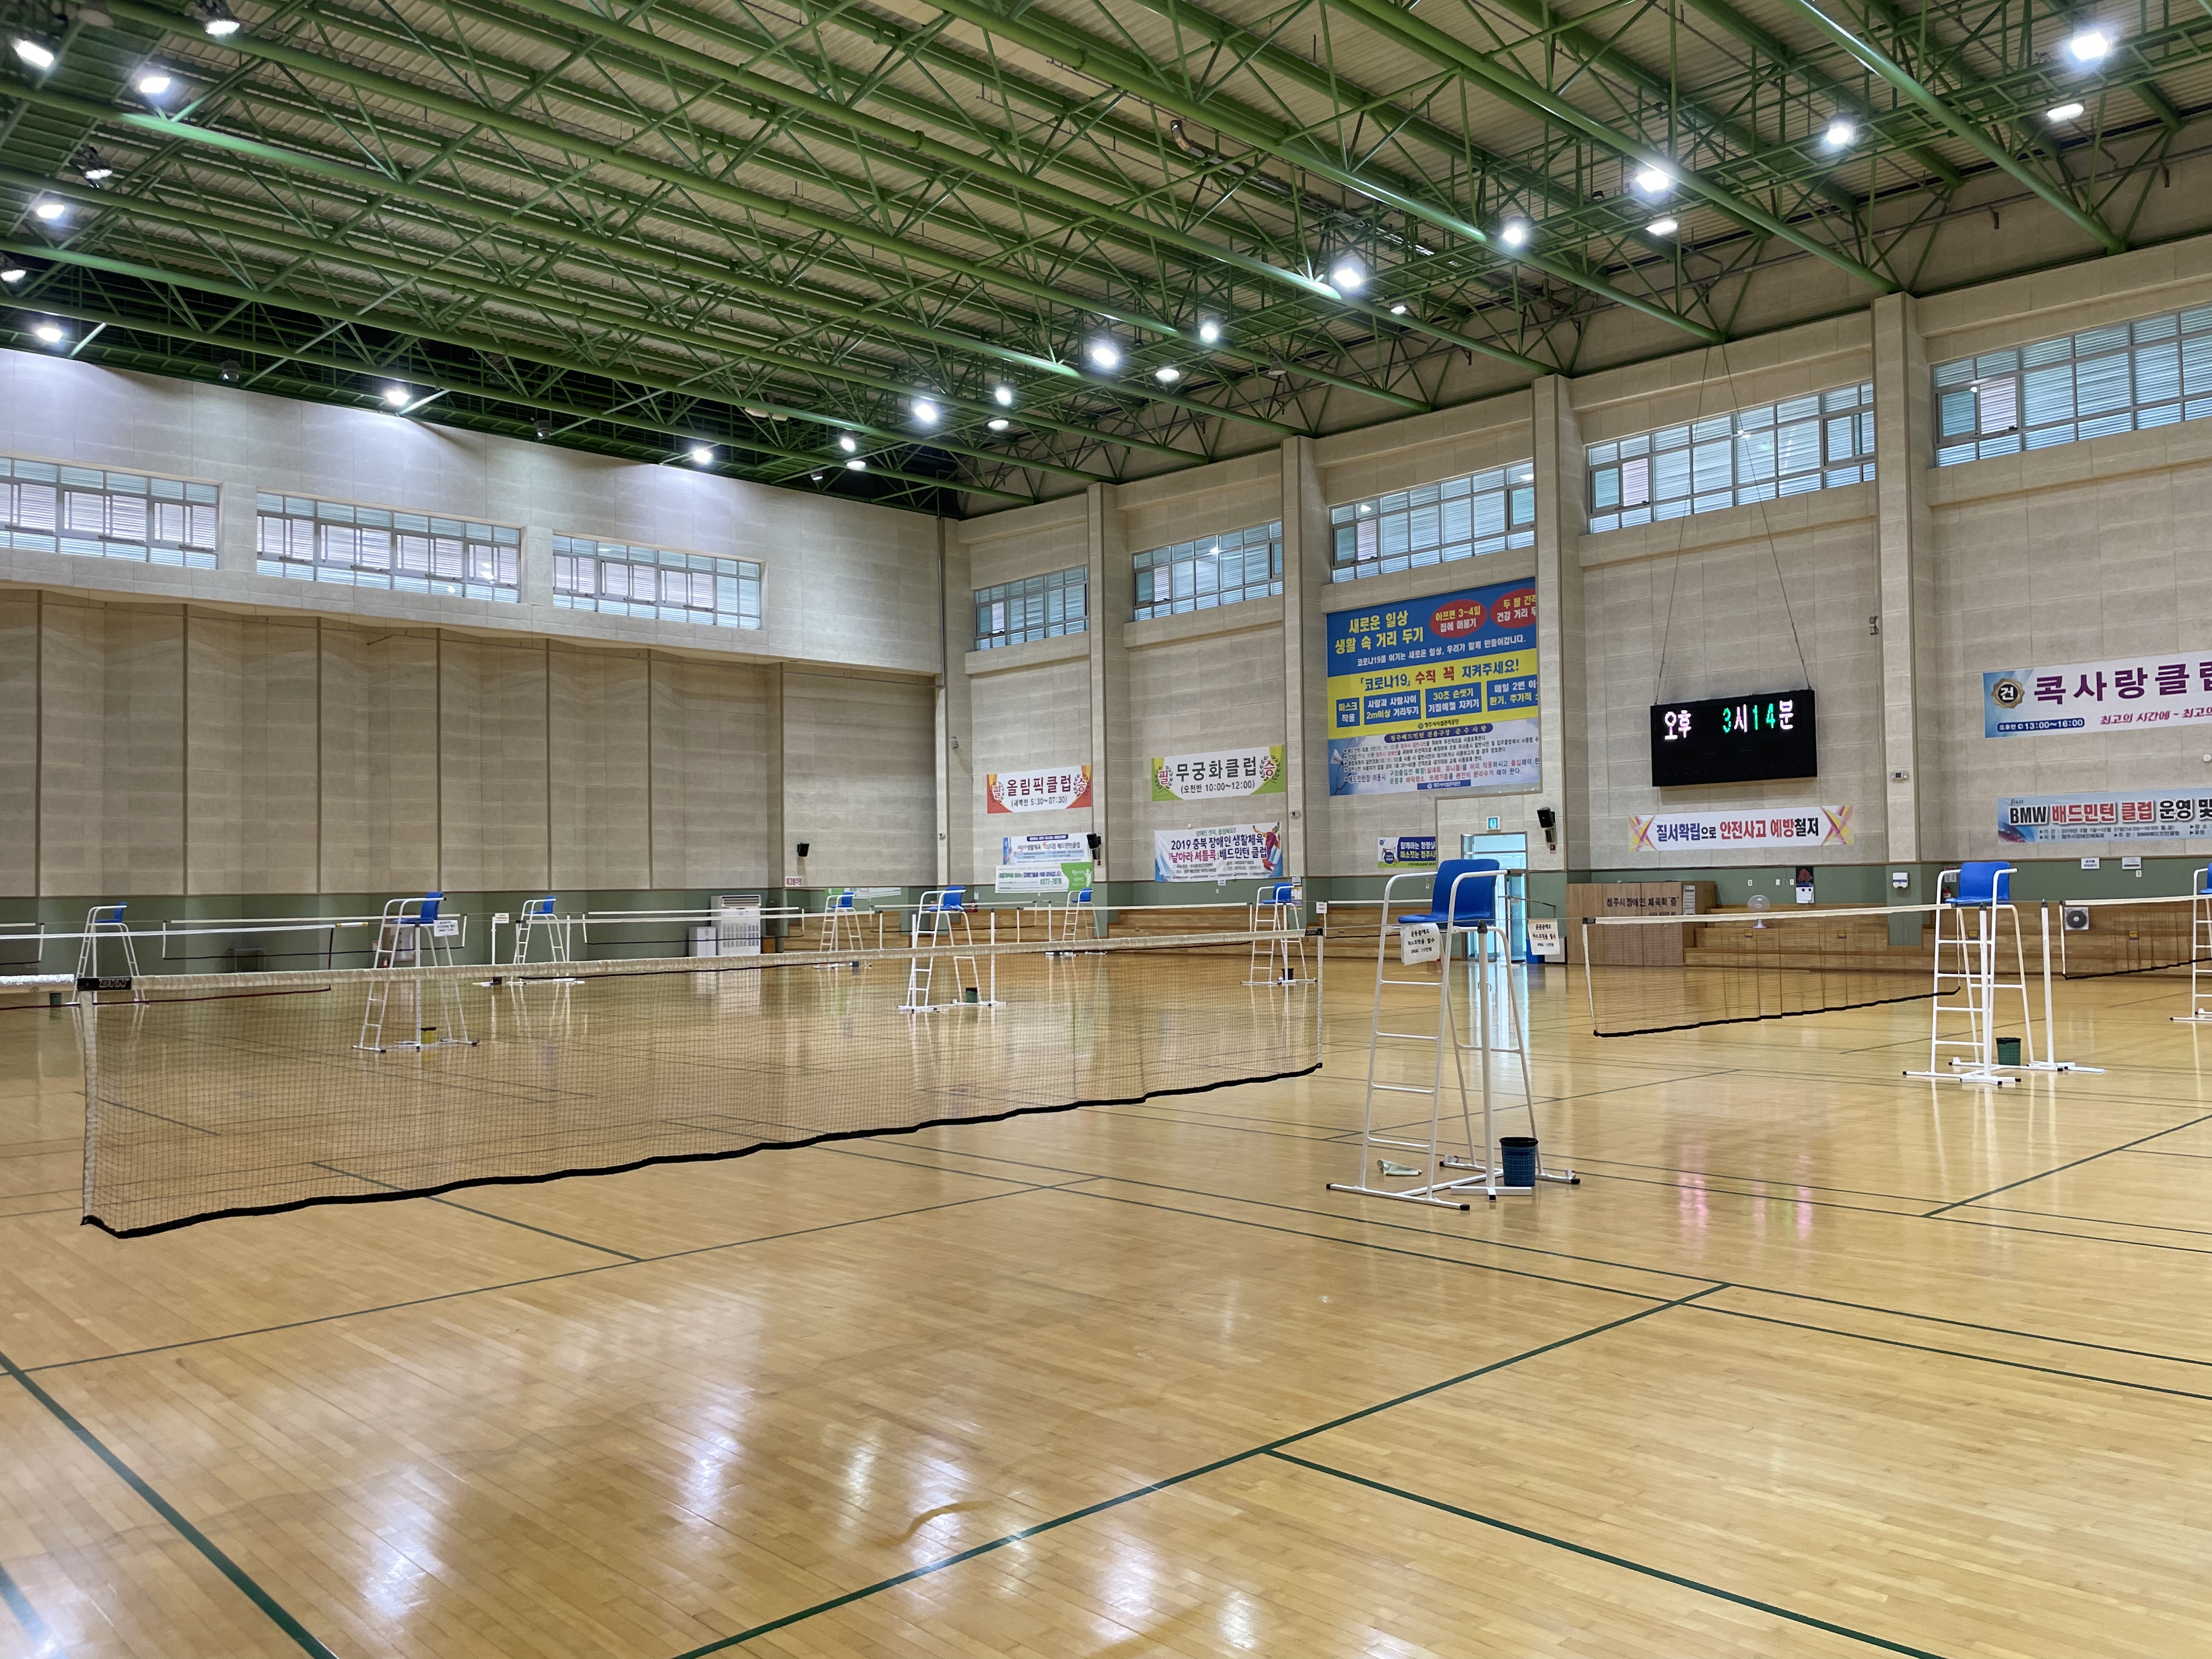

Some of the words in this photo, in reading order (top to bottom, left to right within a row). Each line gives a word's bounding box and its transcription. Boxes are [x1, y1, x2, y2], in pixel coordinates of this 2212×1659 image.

[1503, 599, 1510, 609] 두
[1514, 597, 1521, 608] 팔
[1436, 610, 1455, 621] 아프면
[1458, 606, 1481, 618] 3~4일
[1497, 611, 1510, 622] 건강
[1514, 608, 1528, 619] 거리
[1349, 615, 1380, 633] 새로운
[1386, 610, 1408, 628] 일상
[1440, 623, 1453, 633] 집에
[1457, 618, 1476, 629] 머물기
[1335, 637, 1356, 654] 생활
[1361, 636, 1371, 650] 속
[1376, 631, 1397, 647] 거리
[1403, 627, 1424, 644] 두기
[1357, 655, 1386, 667] 코로나19를
[1389, 652, 1406, 662] 이기는
[1409, 649, 1427, 659] 새로운
[1429, 647, 1444, 657] 일상,
[1447, 644, 1465, 653] 우리가
[1468, 641, 1481, 651] 함께
[1484, 634, 1526, 648] 만들어갑니다.
[1415, 670, 1436, 685] 수칙
[1443, 667, 1454, 680] 꼭
[1462, 659, 1519, 678] 지켜주세요!
[1433, 691, 1450, 701] 30초
[1453, 687, 1473, 698] 손씻기
[1494, 683, 1509, 693] 매일
[1513, 681, 1525, 691] 2번
[2000, 687, 2014, 700] 건
[1339, 702, 1358, 711] 마스크
[1368, 698, 1387, 708] 사람과
[1428, 702, 1456, 713] 기침예절
[1459, 699, 1480, 709] 지키기
[1489, 696, 1506, 706] 환기,
[1510, 692, 1532, 703] 주기적
[1342, 713, 1355, 723] 착용
[1367, 709, 1391, 719] 2m이상
[1393, 706, 1419, 716] 거리두기
[2100, 713, 2133, 725] 최고의
[2136, 710, 2170, 722] 시간에
[1664, 710, 1691, 740] 오후
[1176, 757, 1256, 782] 무궁화클럽
[1264, 760, 1276, 776] 승
[1007, 774, 1071, 796] 올림픽클럽
[1077, 778, 1087, 792] 승
[1159, 770, 1168, 785] 필
[1181, 785, 1202, 794] (오전반
[1205, 780, 1255, 792] 10:00~12:00)
[2010, 806, 2047, 823] BMW
[2052, 803, 2114, 823] 배드민턴
[2122, 801, 2152, 821] 클럽
[2159, 800, 2191, 819] 운영
[1656, 822, 1717, 842] 질서확립으로
[1719, 820, 1767, 840] 안전사고
[1770, 817, 1819, 838] 예방철저
[1171, 839, 1191, 850] 2019
[1193, 838, 1207, 850] 충북
[1209, 837, 1232, 849] 장애인
[1233, 833, 1264, 846] 생활체육
[1251, 847, 1267, 859] 클럽
